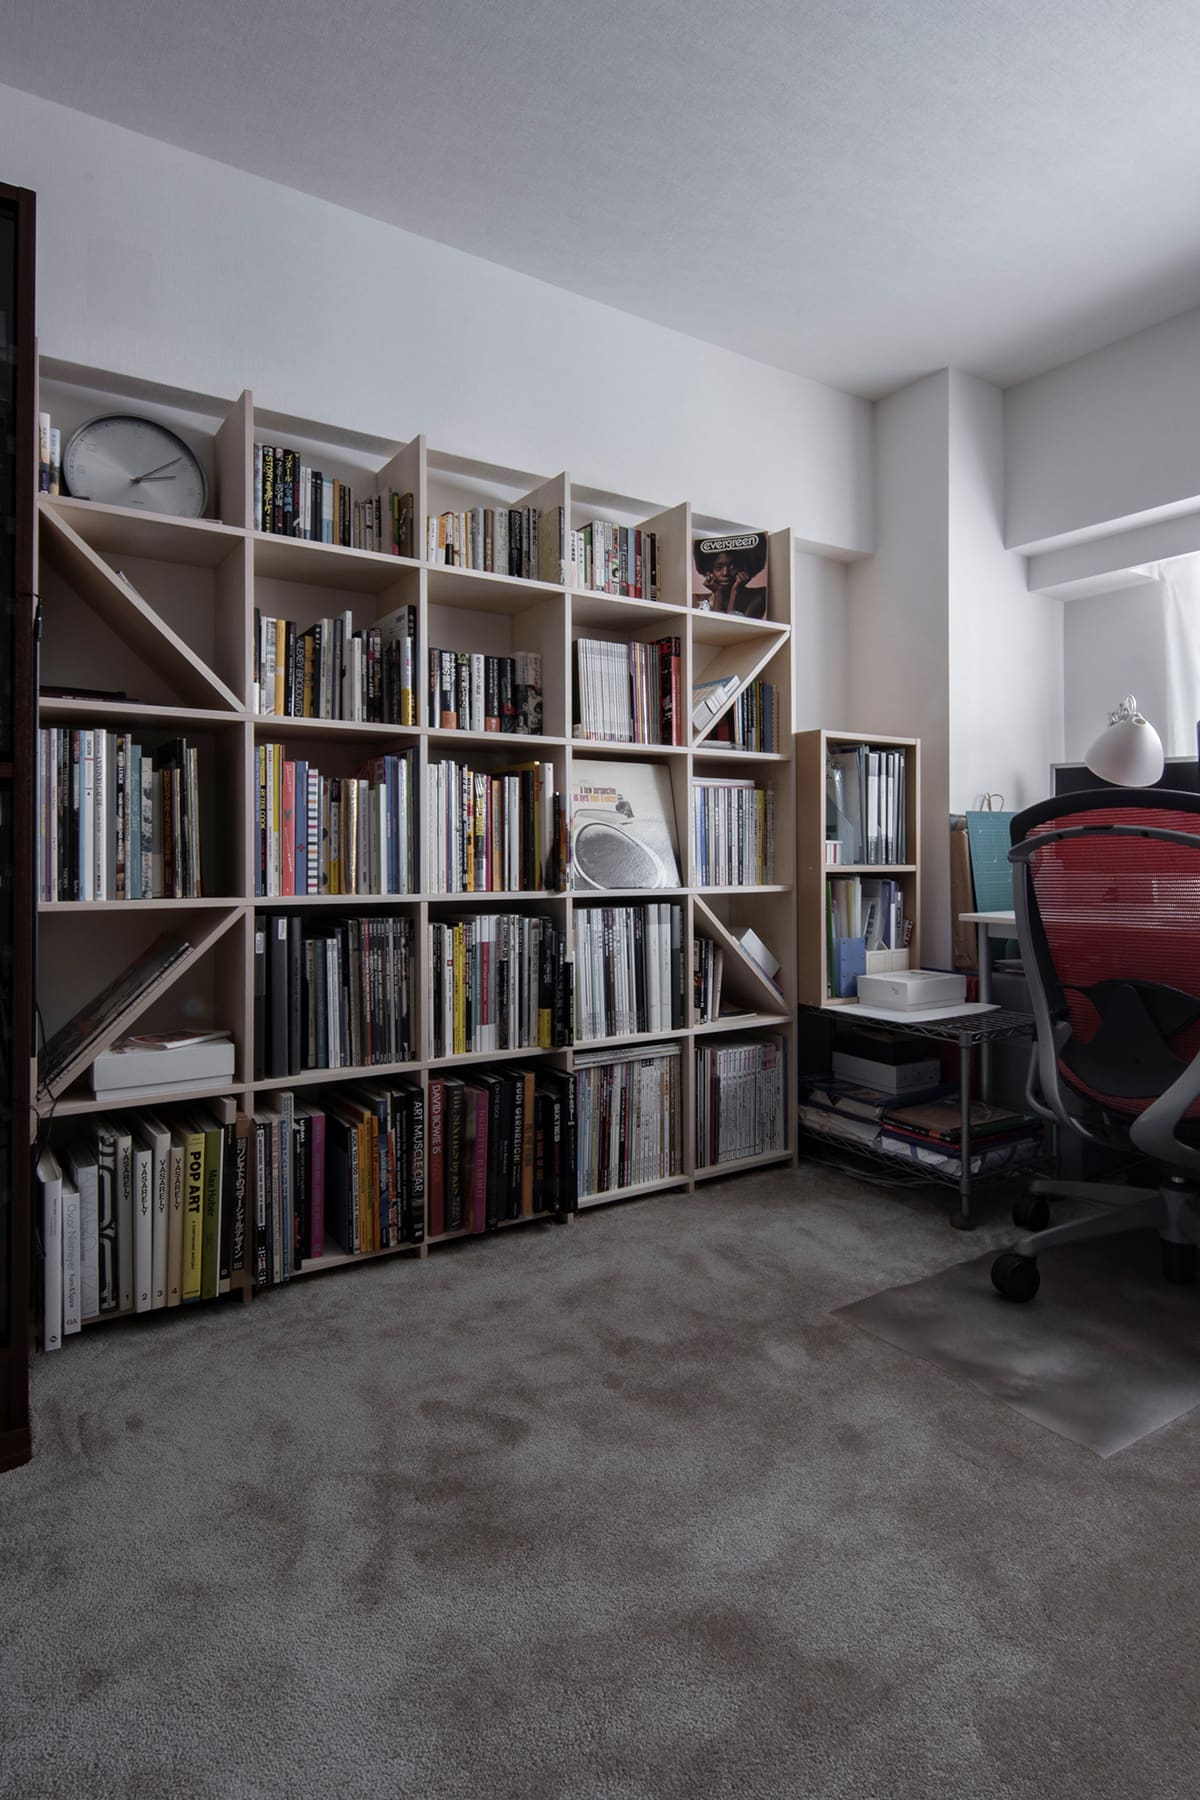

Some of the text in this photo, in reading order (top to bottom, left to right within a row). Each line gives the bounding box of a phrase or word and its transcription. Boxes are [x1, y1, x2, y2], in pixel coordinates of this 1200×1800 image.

[703, 536, 756, 550] evergreen
[296, 639, 304, 667] ALEXEY
[432, 1084, 441, 1114] DAVID
[432, 1115, 442, 1146] BOWIE
[513, 1082, 523, 1161] RUDI GERNREICH
[413, 1101, 424, 1192] ART MUSCLE CAR
[188, 1151, 201, 1182] POP
[188, 1184, 201, 1213] ART
[207, 1169, 217, 1217] Max Huber
[67, 1203, 79, 1229] Oscar
[65, 1230, 78, 1271] Niemeyer
